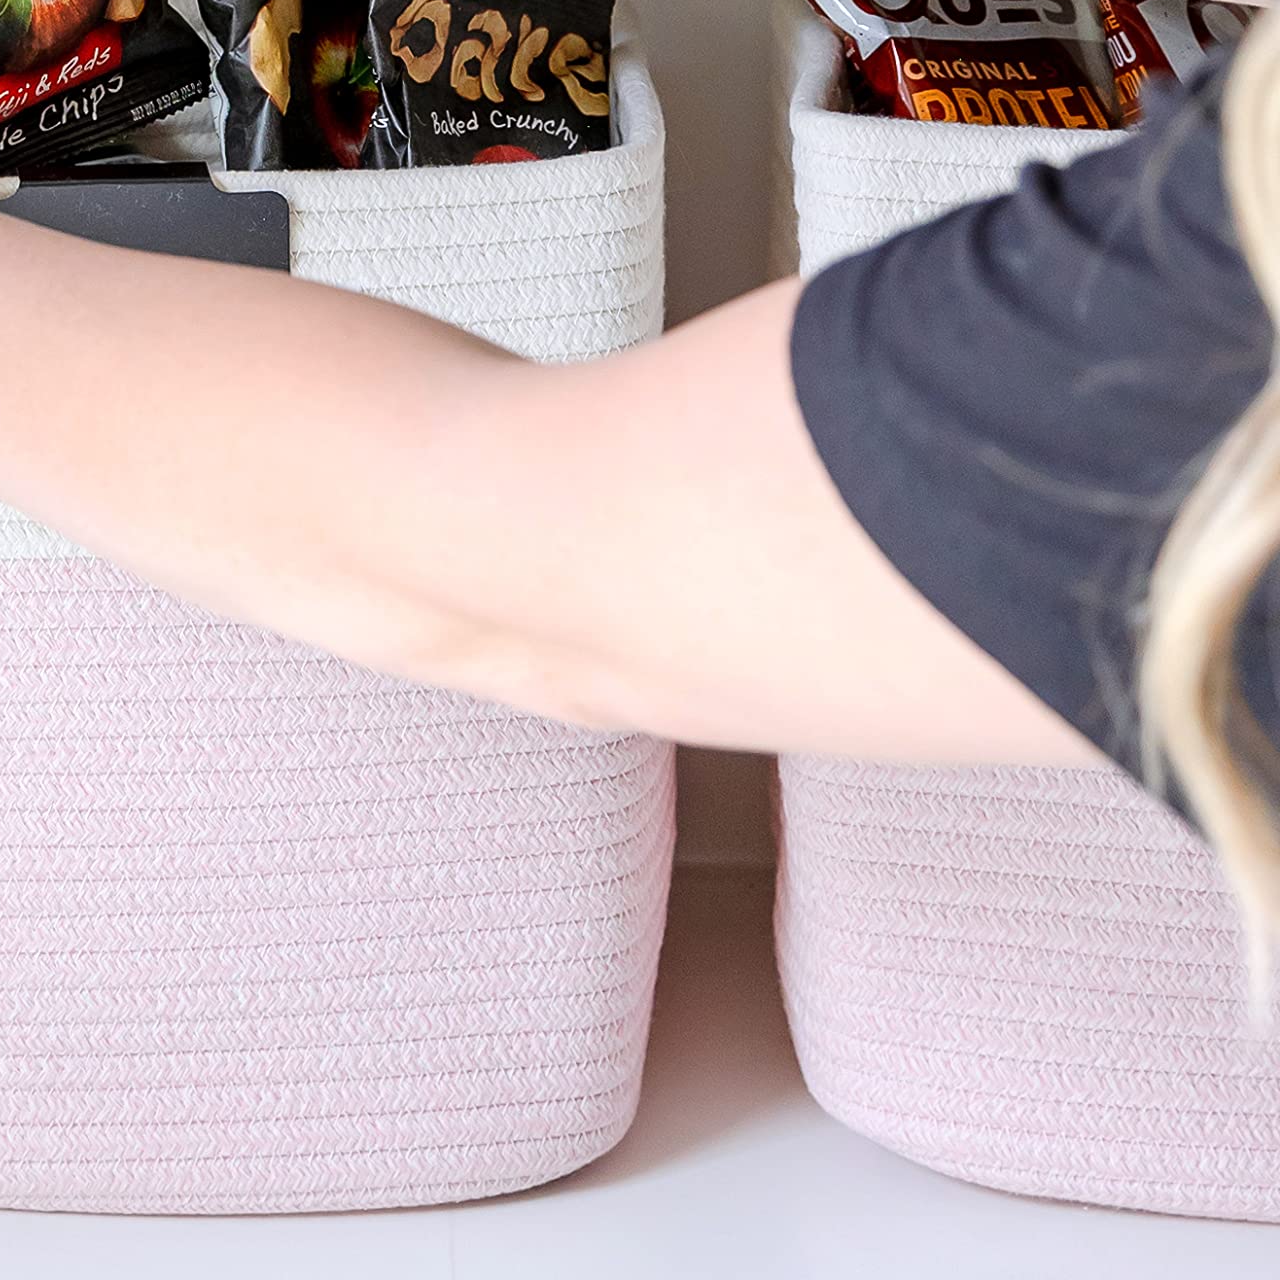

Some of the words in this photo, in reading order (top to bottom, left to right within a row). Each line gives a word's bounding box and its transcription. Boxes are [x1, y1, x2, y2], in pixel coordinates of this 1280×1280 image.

[35, 74, 51, 96] &
[57, 45, 111, 84] Reds
[903, 58, 1037, 81] ORIGINAL
[39, 73, 123, 132] Chips
[431, 111, 480, 136] Baked
[490, 110, 580, 150] Crunchy
